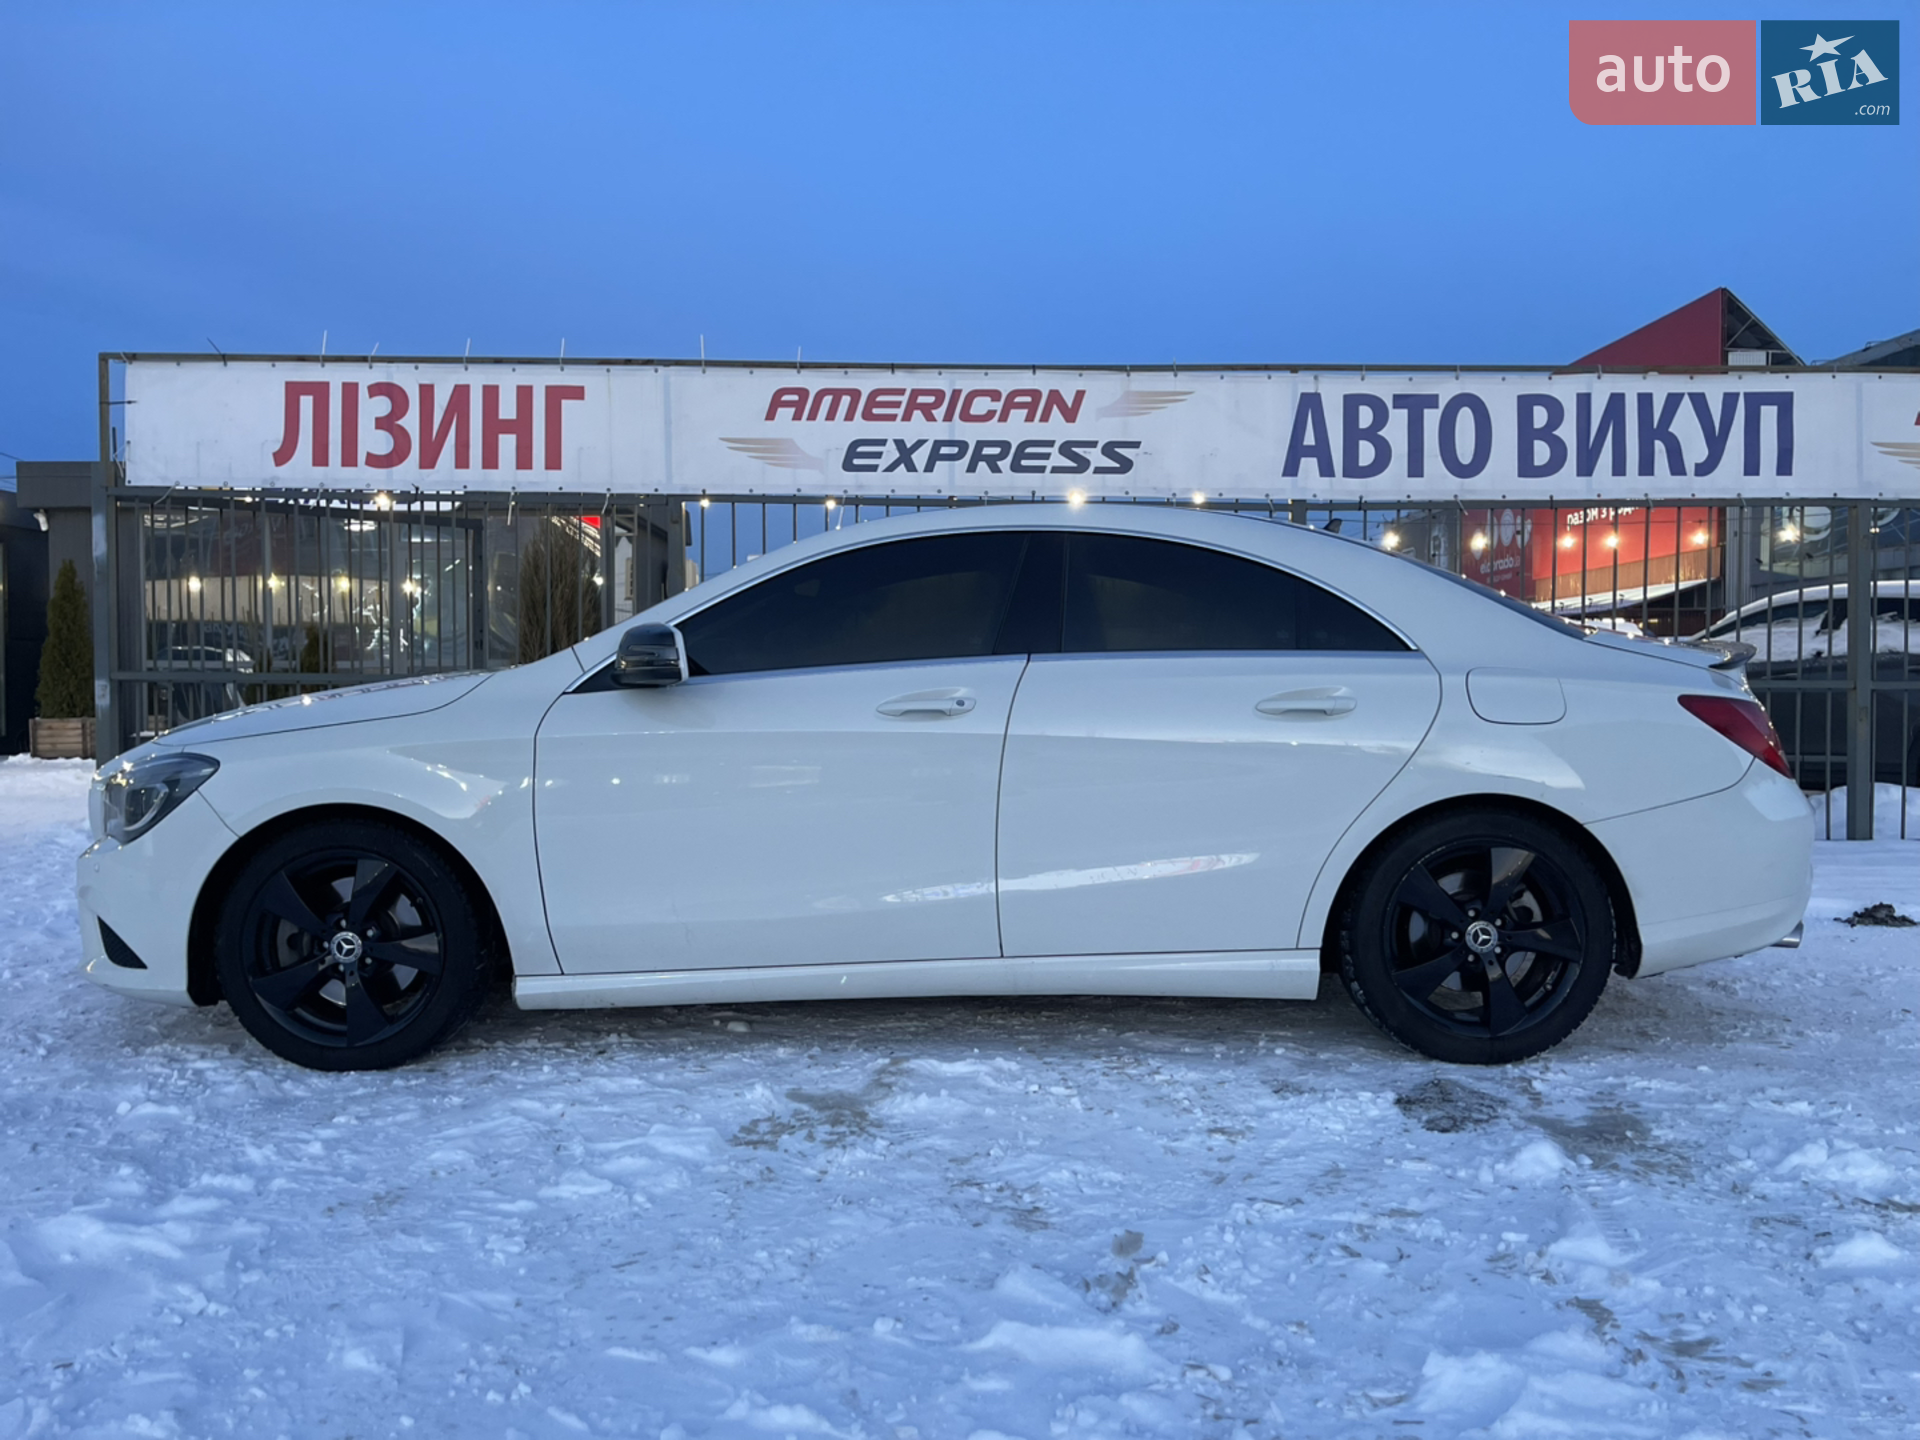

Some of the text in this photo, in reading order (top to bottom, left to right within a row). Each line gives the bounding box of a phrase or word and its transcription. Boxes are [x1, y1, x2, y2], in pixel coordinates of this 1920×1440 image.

[272, 381, 585, 470] ЛІЗИНГ
[764, 386, 1087, 423] AMERICAN
[1281, 391, 1794, 479] АВТО ВИКУП
[841, 438, 1142, 475] EXPRESS
